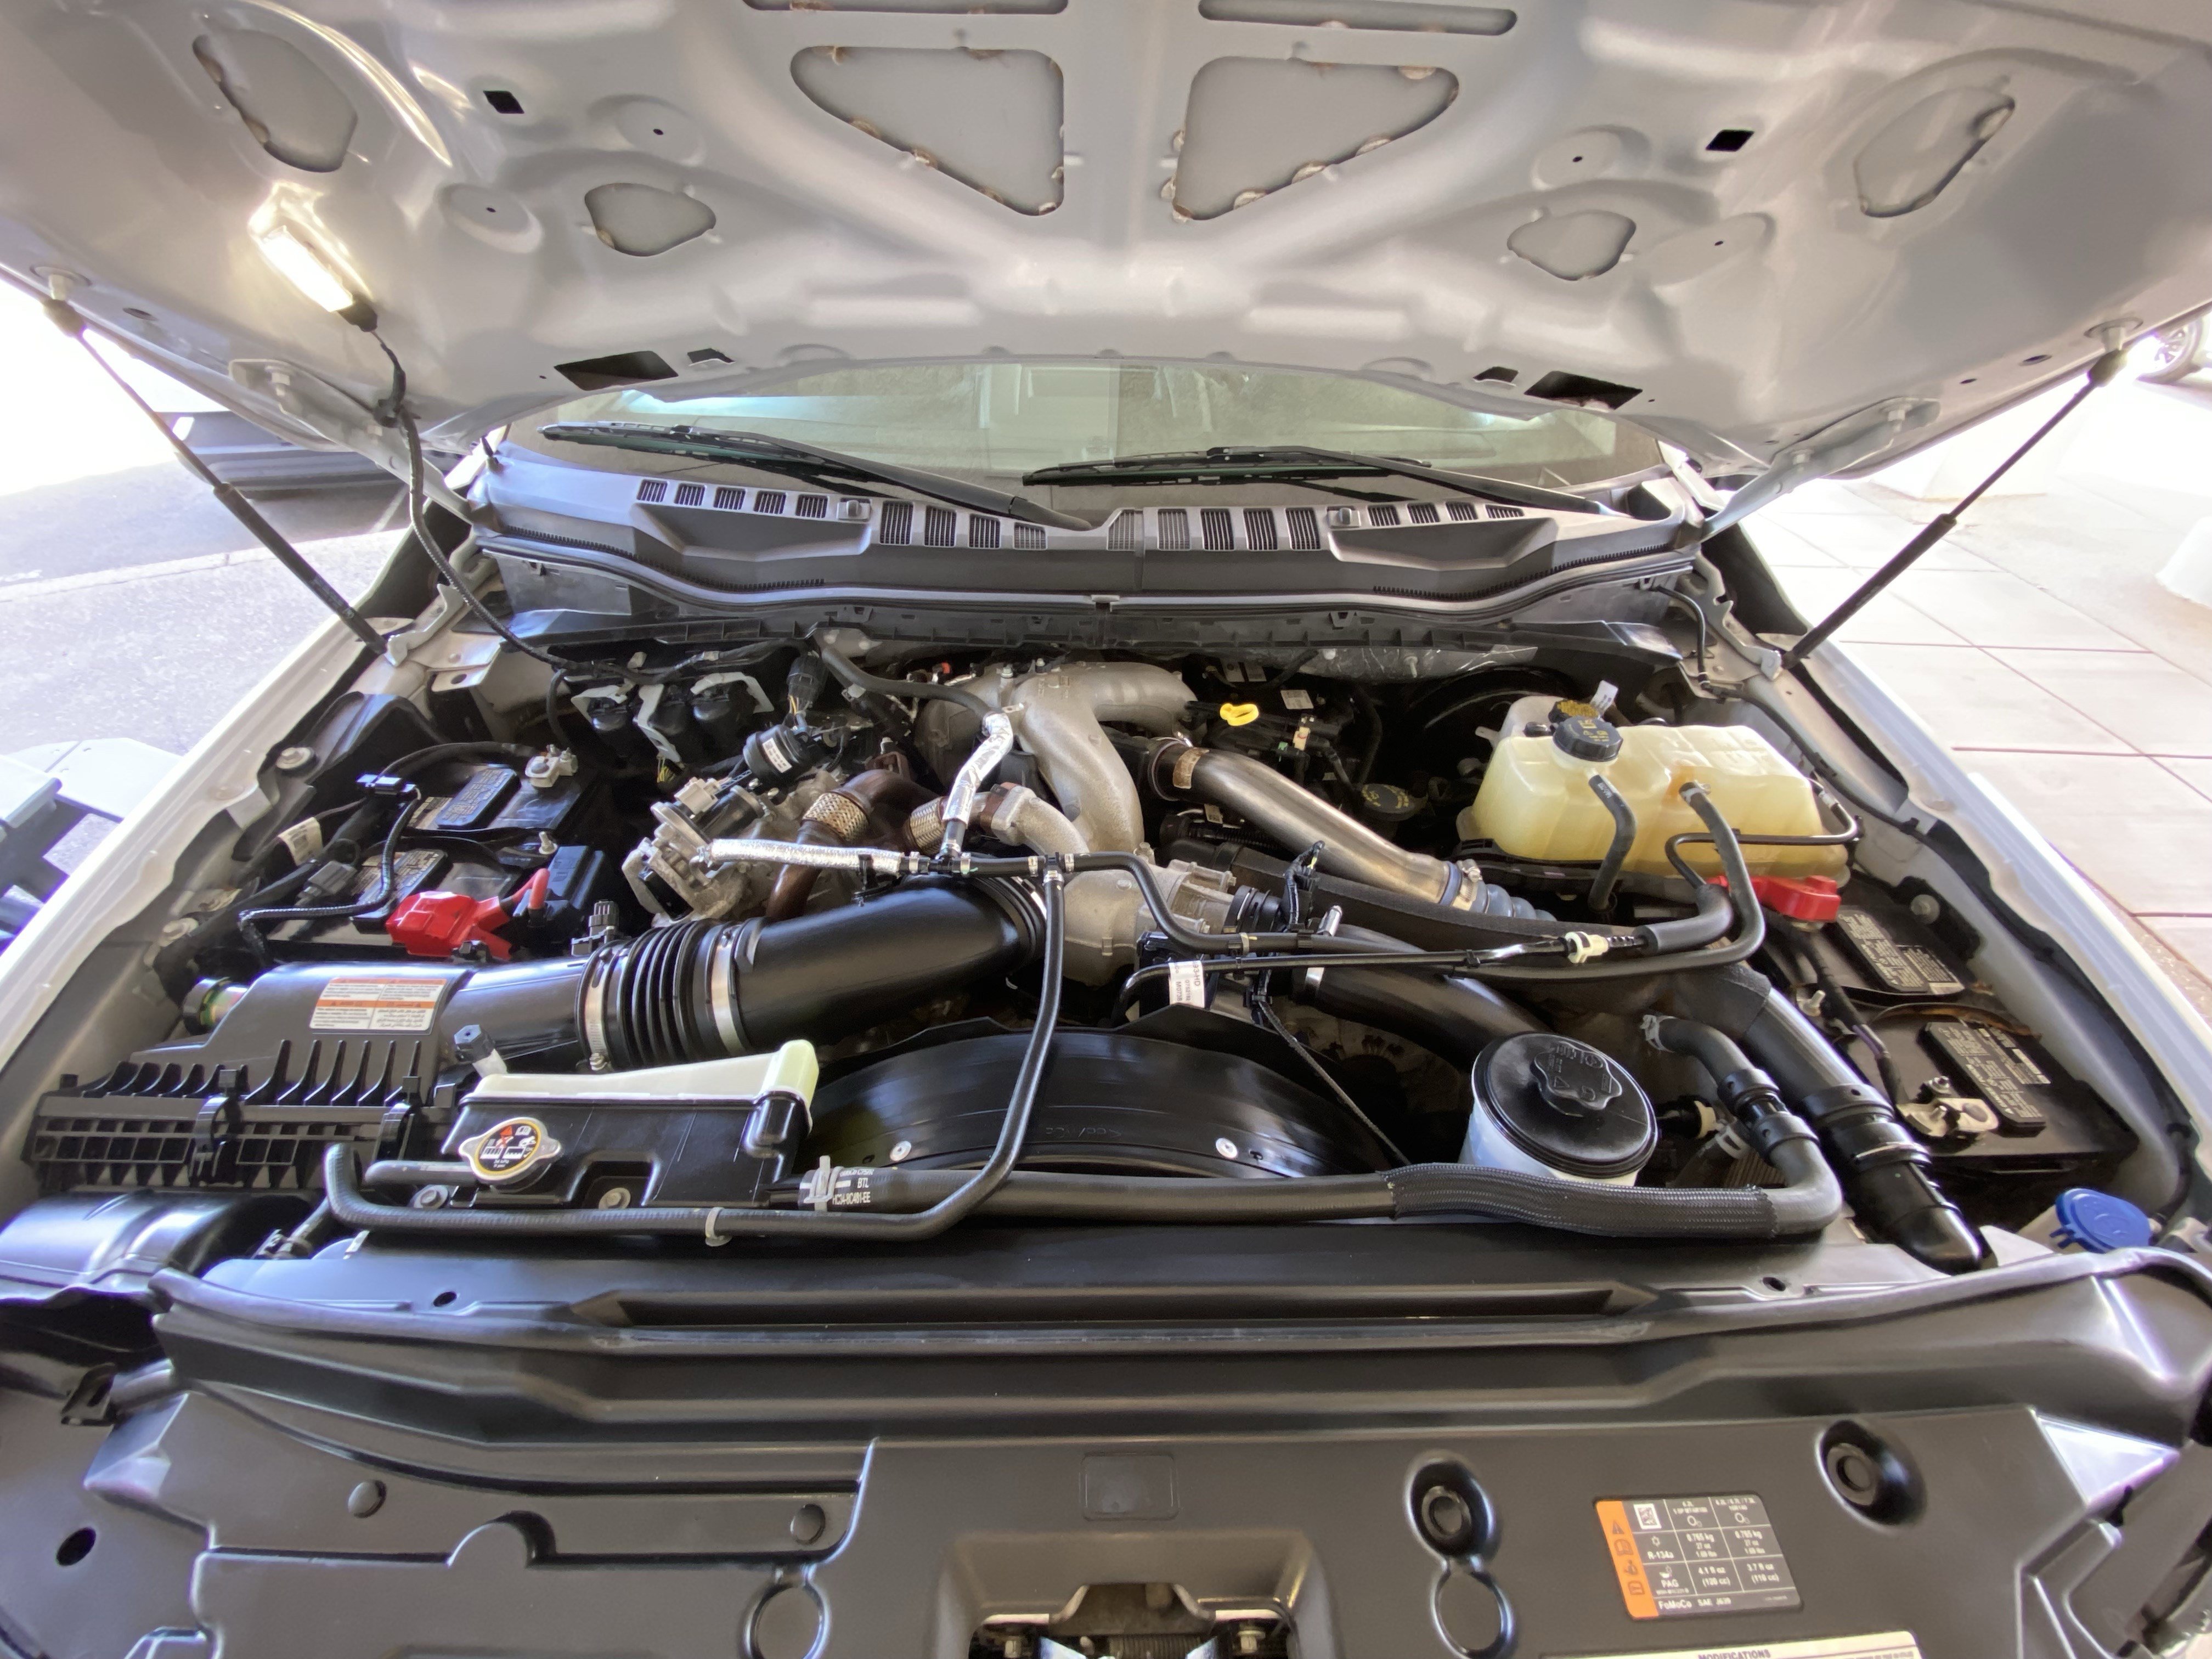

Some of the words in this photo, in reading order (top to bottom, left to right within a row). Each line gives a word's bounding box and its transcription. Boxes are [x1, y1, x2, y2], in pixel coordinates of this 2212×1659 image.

[857, 1177, 869, 1189] BTL
[1647, 1550, 1674, 1560] R-134a
[1718, 1577, 1731, 1586] cc)
[1767, 1573, 1780, 1582] cc)
[1661, 1578, 1679, 1588] PAG
[1658, 1599, 1692, 1610] FoMoCo
[1697, 1598, 1713, 1607] SAE
[1697, 1649, 1771, 1659] MODIFICATIONS
